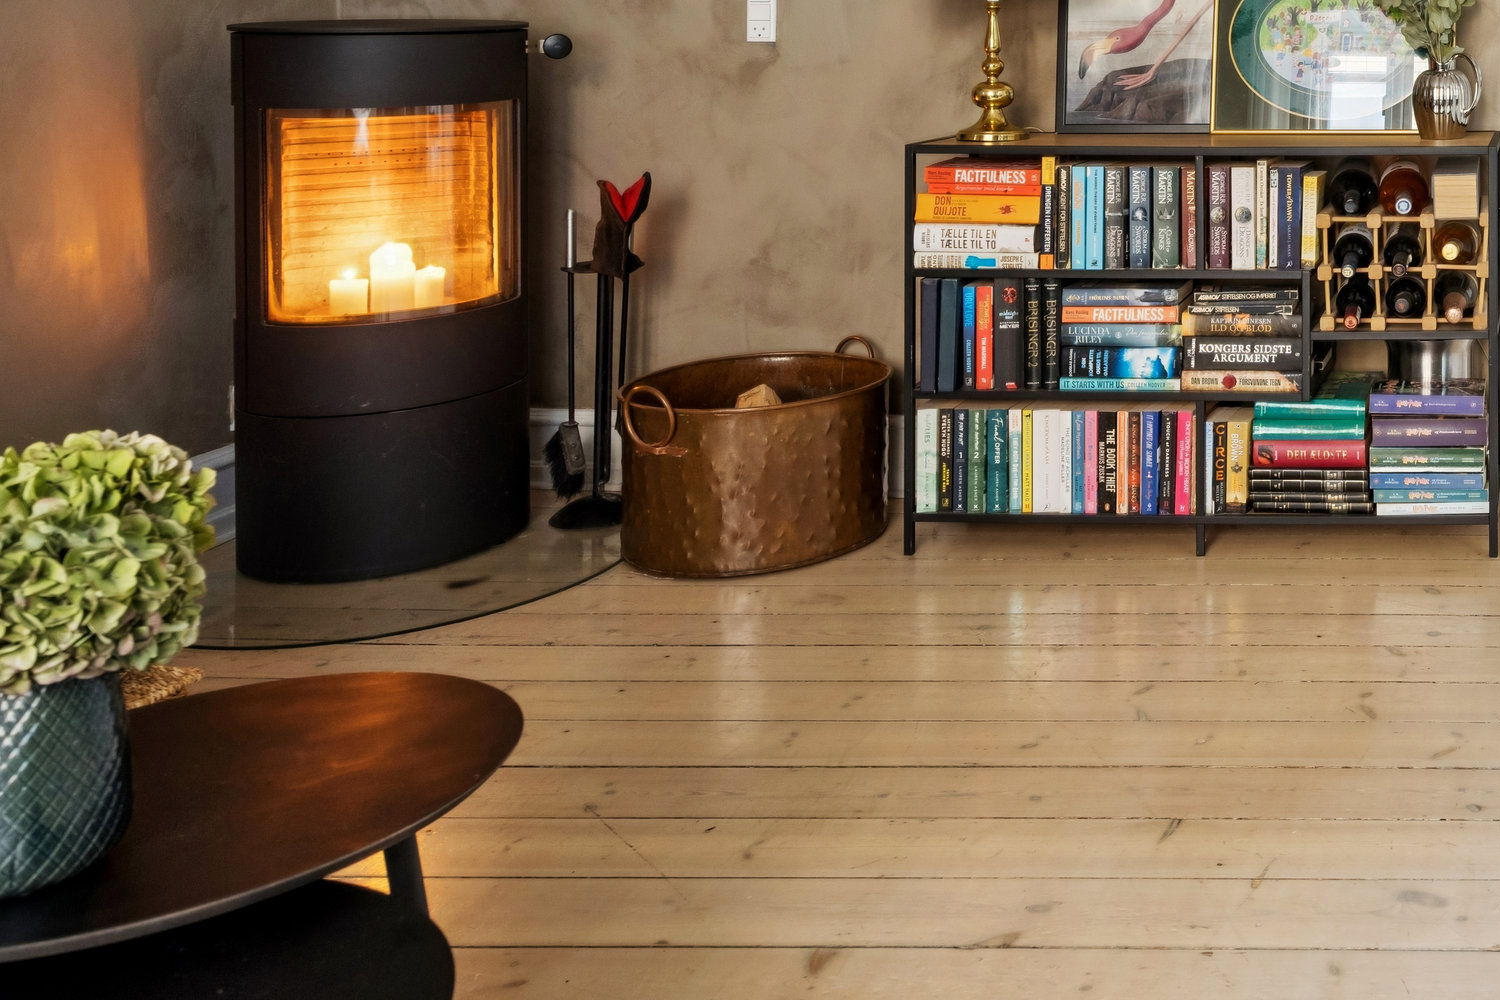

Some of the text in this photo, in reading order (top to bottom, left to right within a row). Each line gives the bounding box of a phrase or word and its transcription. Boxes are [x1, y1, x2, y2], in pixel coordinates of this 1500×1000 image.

[955, 169, 1026, 184] FACTFULNESS
[1107, 170, 1116, 204] MARTIN
[1132, 170, 1140, 204] MARTIN
[1159, 170, 1167, 204] MARTIN
[1186, 171, 1196, 204] MARTIN
[1212, 171, 1220, 204] MARTIN
[935, 196, 951, 205] DON
[1044, 186, 1052, 215] DRENGEN
[933, 207, 967, 216] QUIJOTE
[941, 229, 967, 239] TÆLLE
[971, 229, 983, 239] TIL
[986, 230, 997, 239] EN
[941, 239, 967, 249] TÆLLE
[971, 240, 983, 250] TIL
[986, 240, 996, 250] TO
[1188, 228, 1196, 252] CROWS
[1093, 308, 1164, 321] FACTFULNESS
[1025, 300, 1038, 359] BRISINGR
[1044, 300, 1057, 358] BRISINGR
[1068, 326, 1110, 335] LUCINDA
[1075, 336, 1103, 344] RILEY
[1198, 344, 1292, 354] KONGERS SIDSTE
[1213, 354, 1277, 363] ARGUMENT
[1071, 381, 1095, 389] STARTS
[1096, 381, 1114, 389] WITH
[1115, 381, 1124, 389] US
[1269, 378, 1281, 386] TEGN
[1408, 399, 1422, 408] Potter
[992, 417, 1004, 442] Final
[1417, 428, 1432, 436] Potter
[1215, 424, 1225, 481] CIRCE
[1231, 433, 1239, 462] BROWN
[1287, 450, 1306, 460] DEN
[1310, 450, 1348, 460] ÆLDSTE
[1414, 455, 1428, 464] Potter
[1106, 429, 1115, 493] THE BOOK THIEF
[1415, 477, 1430, 486] Potter
[1420, 491, 1435, 499] Potter
[1423, 504, 1438, 513] Potter
